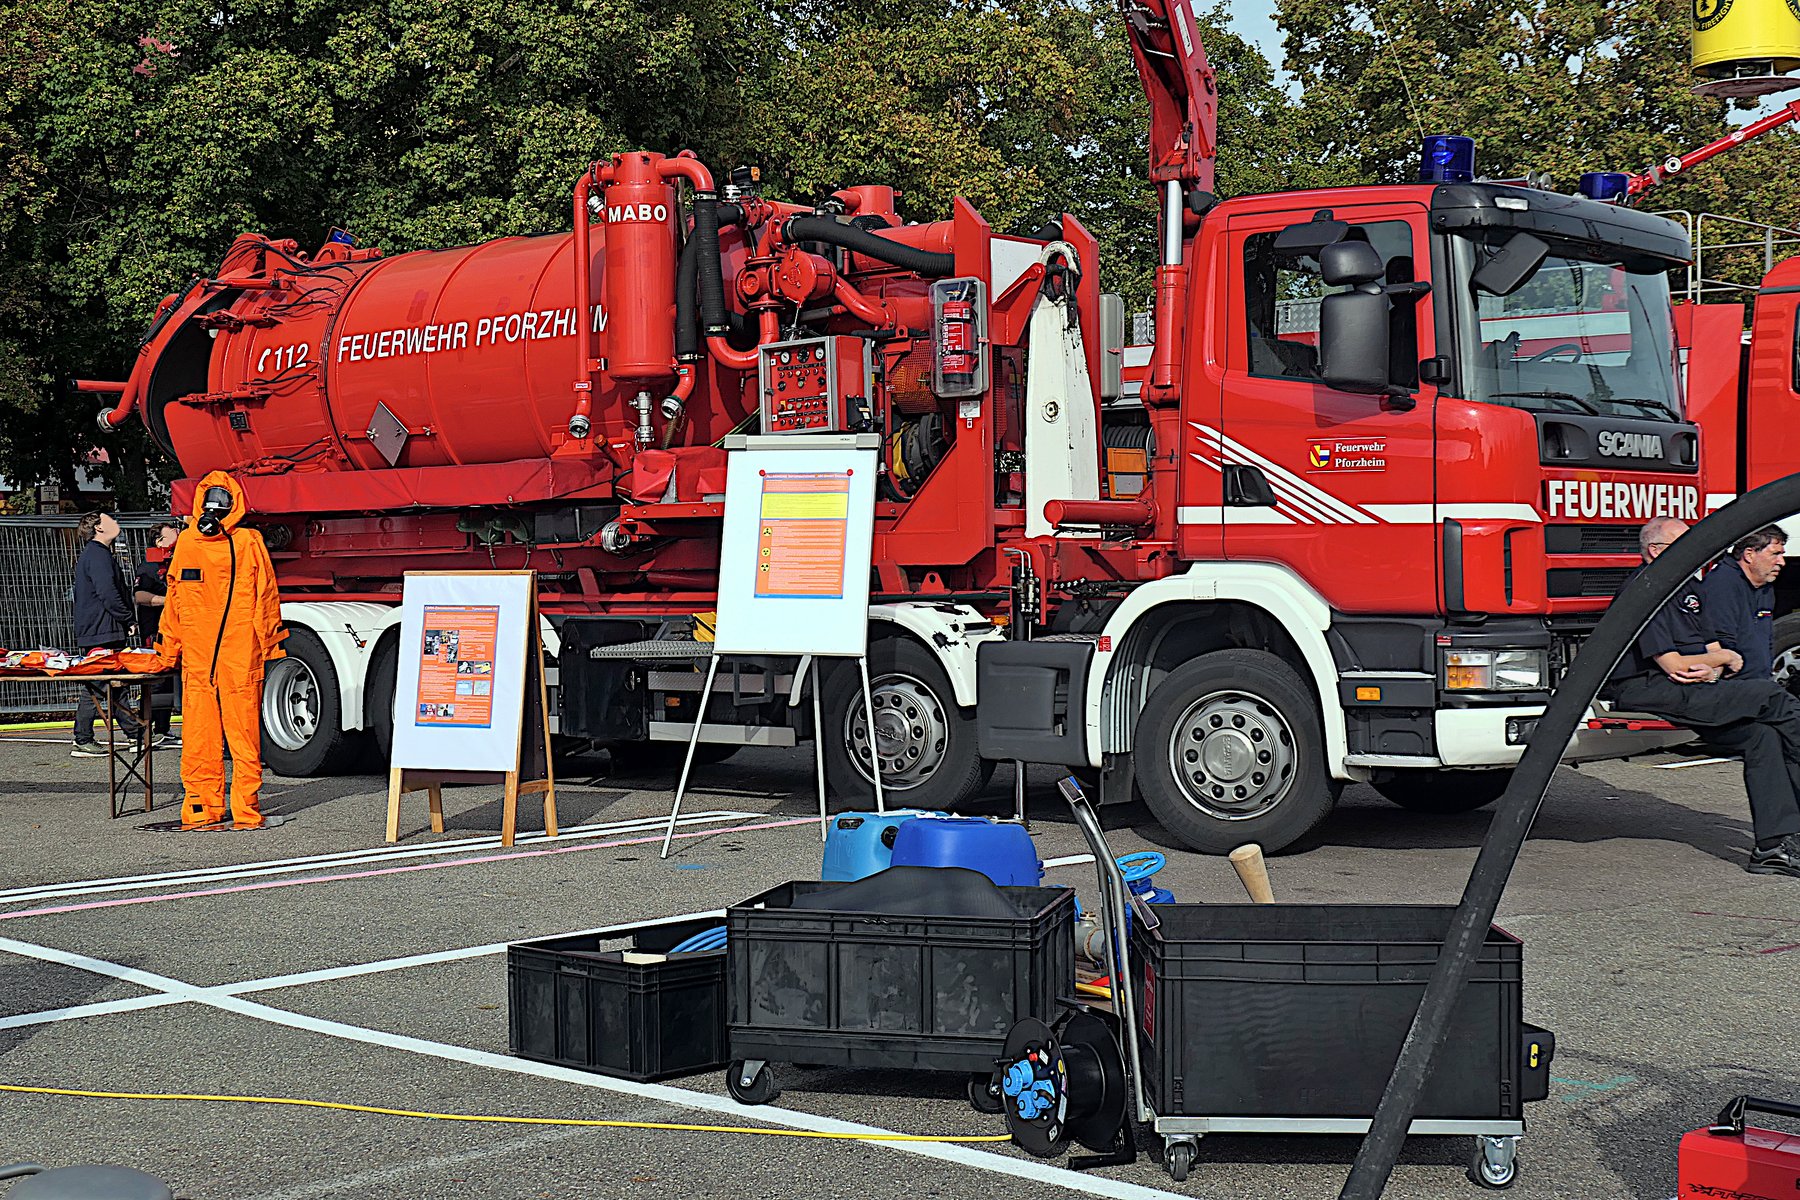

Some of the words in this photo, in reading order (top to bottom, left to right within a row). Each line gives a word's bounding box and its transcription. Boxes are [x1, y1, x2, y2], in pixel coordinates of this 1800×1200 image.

[608, 204, 667, 223] MABO
[338, 321, 467, 363] FEUERWEHR
[475, 304, 608, 347] PFORZHM
[274, 343, 309, 371] 112
[1334, 441, 1386, 453] Feuerwehr
[1598, 431, 1663, 459] SCANIA
[1334, 457, 1386, 468] Pforzheim
[1548, 480, 1699, 520] FEUERWEHR
